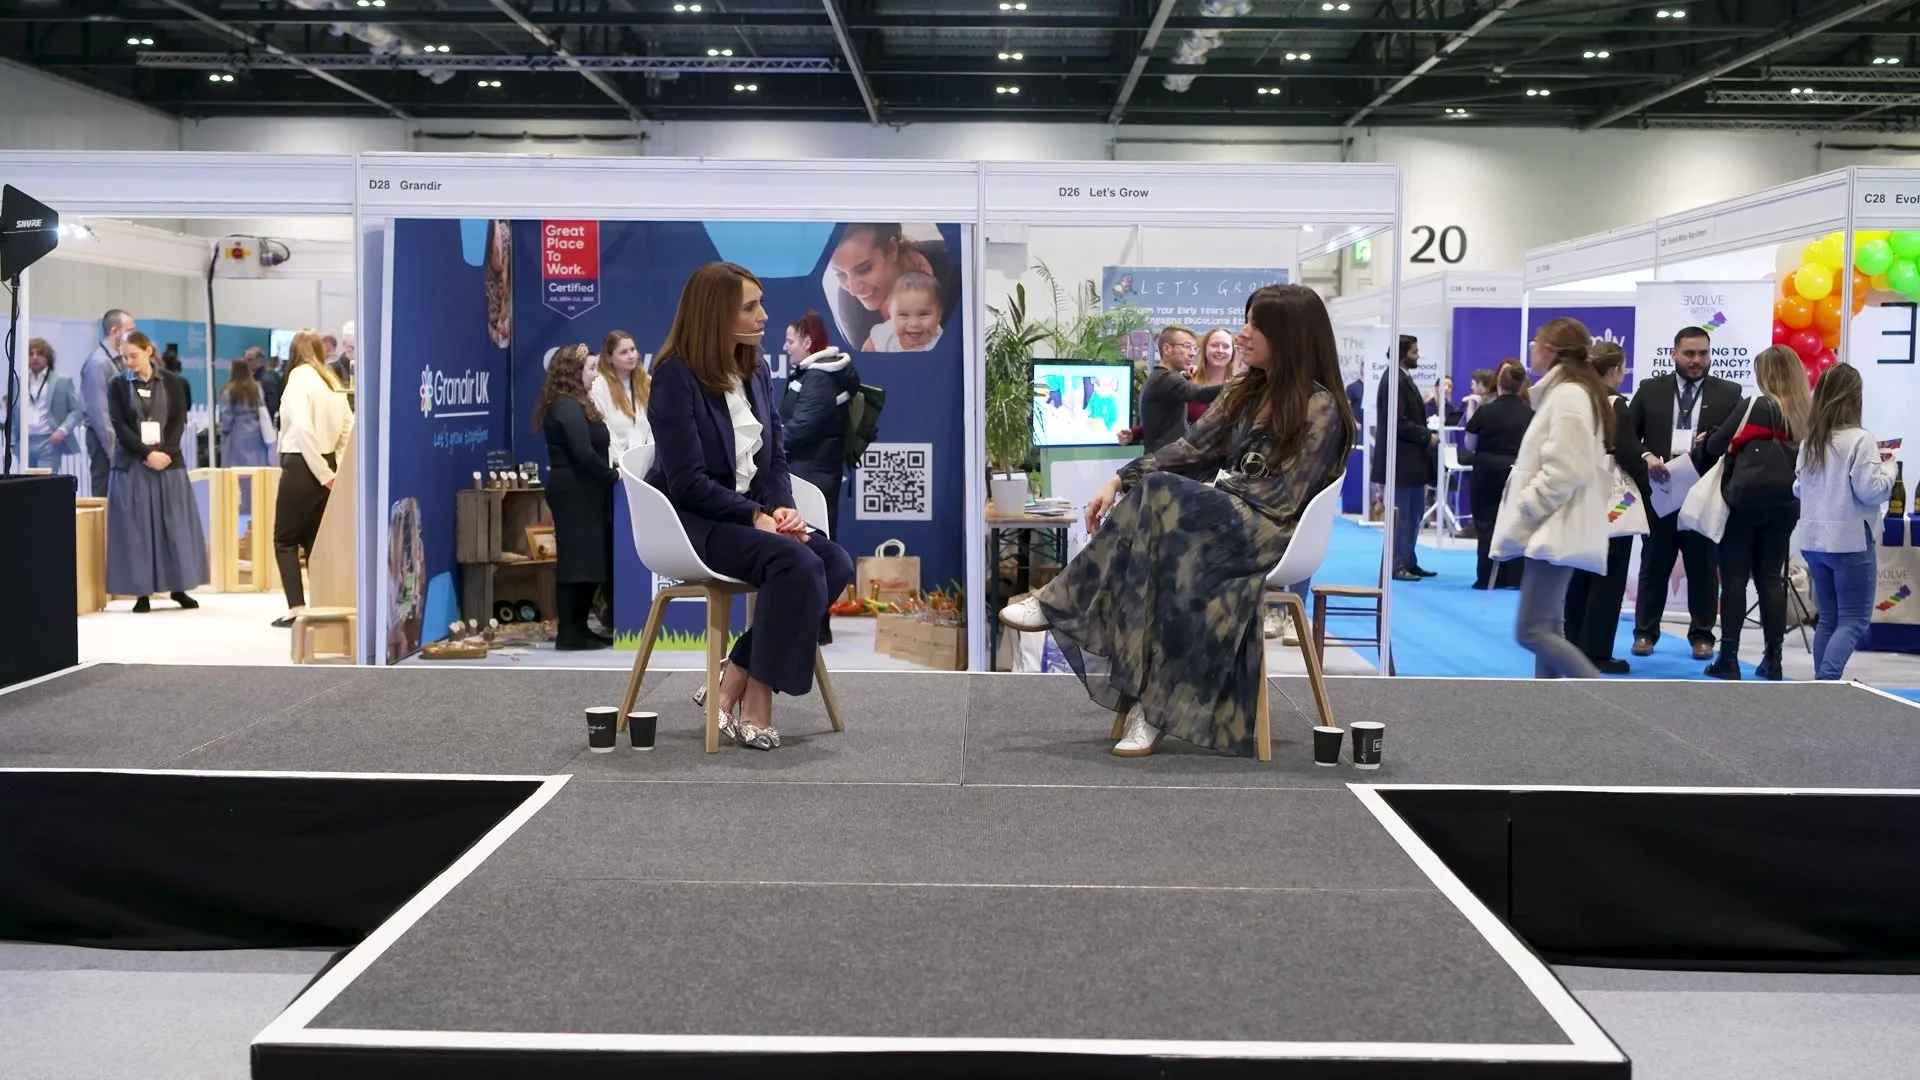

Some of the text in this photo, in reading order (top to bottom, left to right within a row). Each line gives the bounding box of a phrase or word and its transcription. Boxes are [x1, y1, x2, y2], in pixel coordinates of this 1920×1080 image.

[369, 180, 442, 191] D28 Grandir
[1059, 187, 1149, 197] D26 Let's Grow
[1864, 193, 1886, 203] C28
[15, 219, 43, 228] SHURE
[545, 224, 584, 236] Great
[547, 237, 584, 249] Place
[1410, 225, 1467, 264] 20
[546, 250, 561, 261] To
[548, 283, 594, 293] Certified
[1141, 280, 1199, 296] LET'S
[1156, 306, 1175, 315] Your
[1177, 306, 1197, 317] Early
[1200, 306, 1225, 315] Years
[1732, 347, 1747, 356] TO
[1653, 358, 1673, 367] FILL
[434, 368, 489, 406] Grandir UK
[1877, 570, 1909, 579] VOLVE
